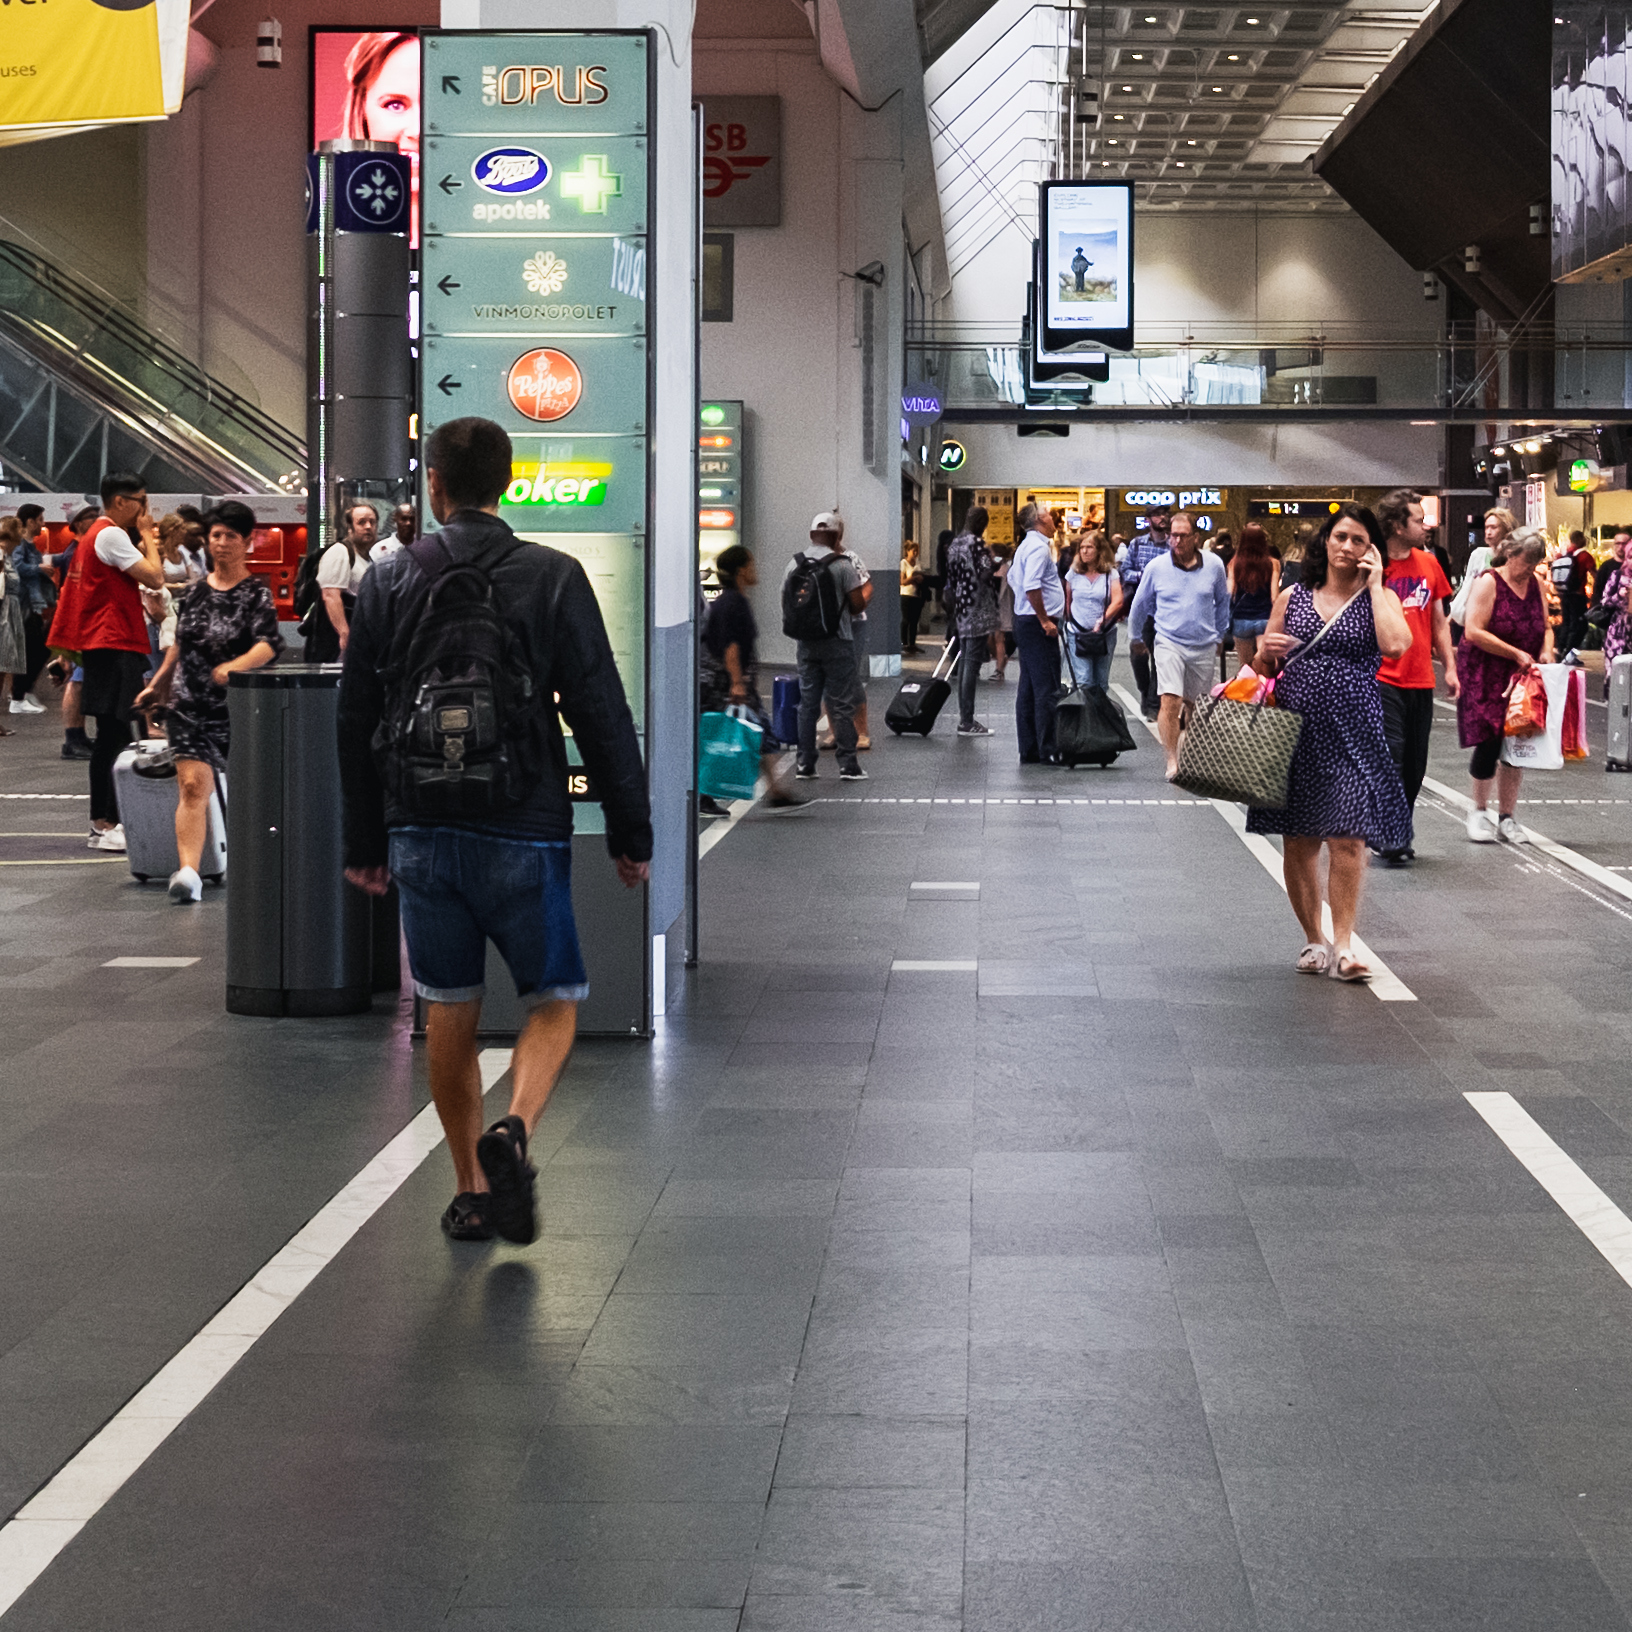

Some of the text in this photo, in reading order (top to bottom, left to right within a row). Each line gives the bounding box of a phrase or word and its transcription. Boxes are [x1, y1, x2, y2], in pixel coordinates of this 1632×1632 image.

[481, 65, 608, 106] CAFE OPUS
[705, 123, 747, 152] SB
[481, 155, 540, 186] Boots
[473, 199, 551, 223] apotek
[474, 304, 617, 321] VINMONOPOLET
[514, 373, 573, 398] Peppes
[505, 463, 599, 503] oker
[1125, 487, 1221, 509] coop prix
